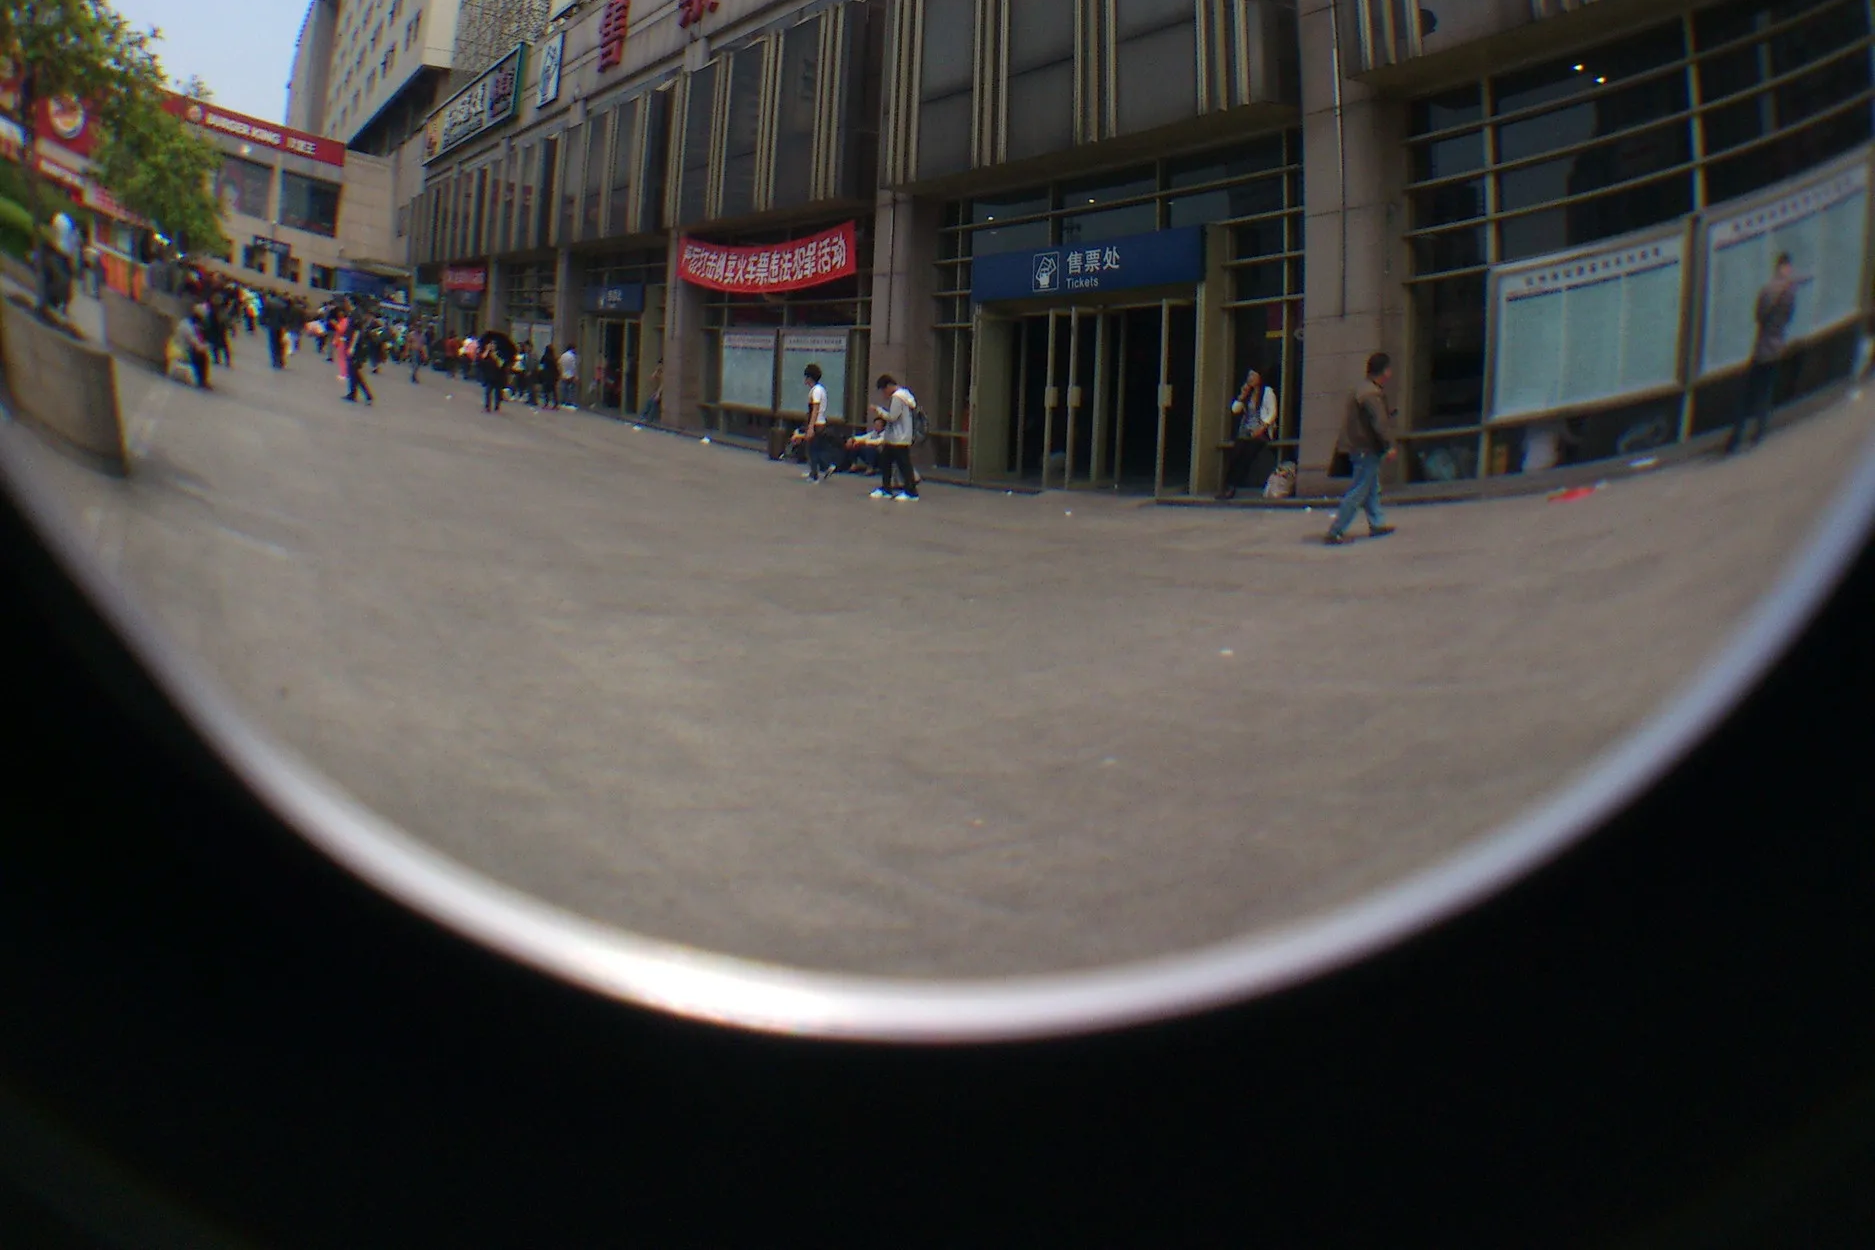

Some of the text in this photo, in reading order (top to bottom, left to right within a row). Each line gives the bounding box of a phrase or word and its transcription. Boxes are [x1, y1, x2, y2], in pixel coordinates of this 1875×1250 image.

[1066, 246, 1121, 275] 售票处
[1066, 275, 1099, 289] Tickets
